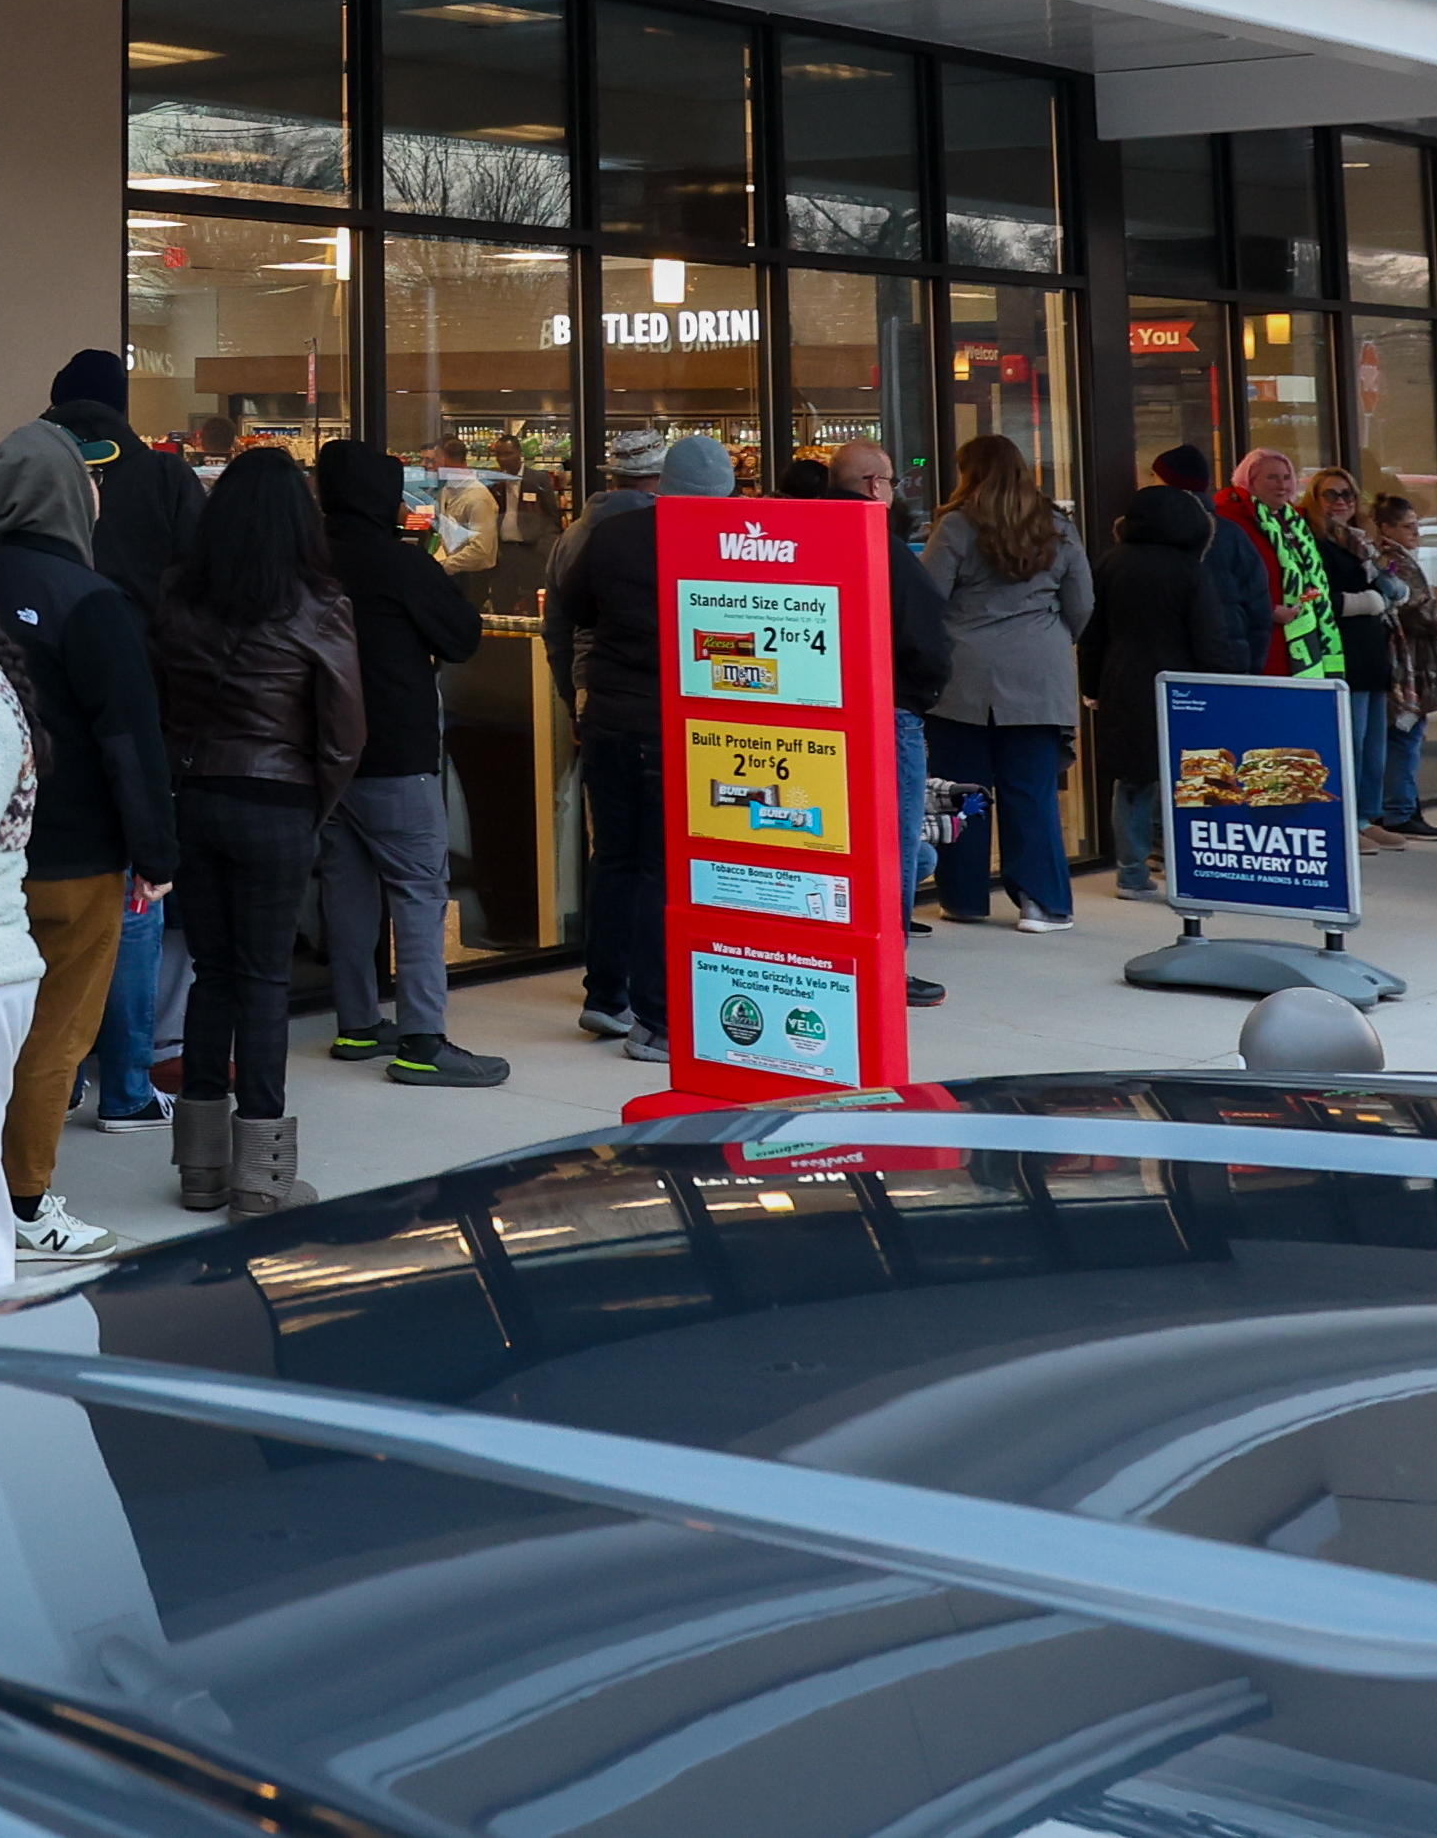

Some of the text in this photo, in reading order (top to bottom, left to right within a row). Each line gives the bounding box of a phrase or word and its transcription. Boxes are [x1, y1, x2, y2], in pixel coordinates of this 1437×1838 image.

[553, 309, 760, 345] BTLED DRIN
[1138, 328, 1180, 346] You
[719, 532, 796, 563] Wawa
[690, 593, 827, 616] Standard Size Candy
[763, 627, 827, 655] 2 for $4
[692, 732, 836, 756] Built Protein Puff Bars
[733, 754, 790, 780] 2 for $6
[1190, 820, 1328, 858] ELEVATE
[711, 863, 802, 882] Tobacco Bonus Offers
[1192, 850, 1328, 875] YOUR EVERY DAY
[1193, 870, 1255, 882] CUSTOMIZABLE
[1302, 879, 1329, 888] CLUBS
[712, 942, 833, 969] Wawa Rewards Members
[697, 960, 850, 993] Save More on Grizzly & Velo Plus
[732, 978, 815, 1000] Nicotine Pouches!
[788, 1018, 823, 1034] VELO
